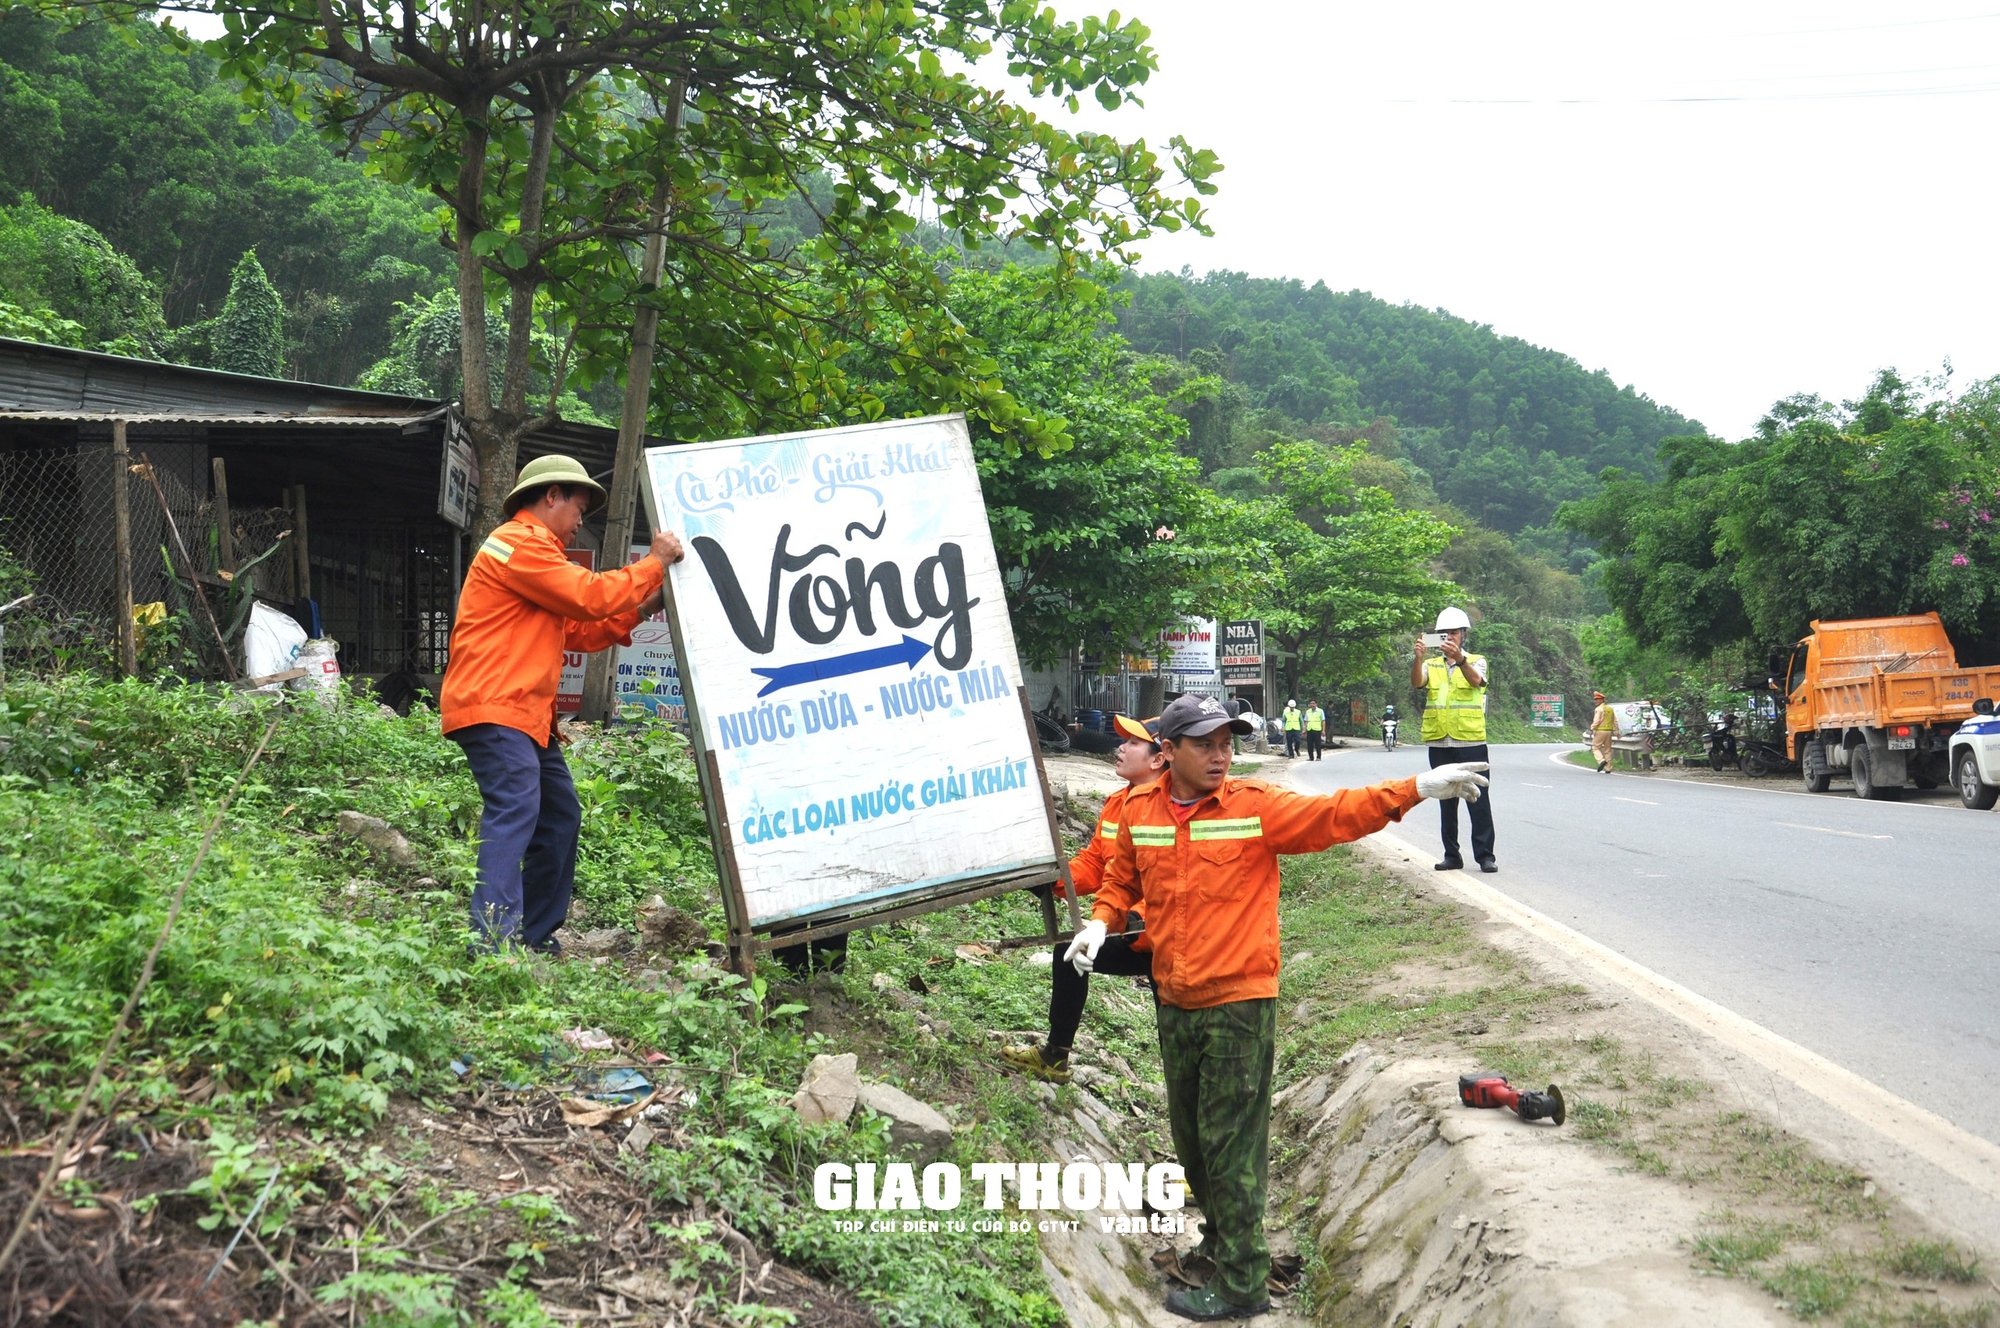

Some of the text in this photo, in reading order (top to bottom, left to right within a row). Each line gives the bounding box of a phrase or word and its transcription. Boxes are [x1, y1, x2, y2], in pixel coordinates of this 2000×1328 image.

[715, 464, 780, 499] Phê
[812, 451, 884, 508] Giải
[691, 510, 980, 671] Võng
[1226, 622, 1256, 638] NHÀ
[644, 650, 674, 660] Chuyê
[1225, 638, 1258, 656] NGHỈ
[1951, 678, 1968, 687] 43C
[1945, 690, 1974, 700] 284.42
[656, 704, 686, 719] THAY
[718, 700, 795, 750] NƯỚC
[800, 689, 858, 734] DỪA
[879, 671, 953, 719] NƯỚC
[957, 660, 1010, 704] MÍA
[743, 756, 1027, 844] CÁC LOẠI NƯỚC GIẢI KHÁT
